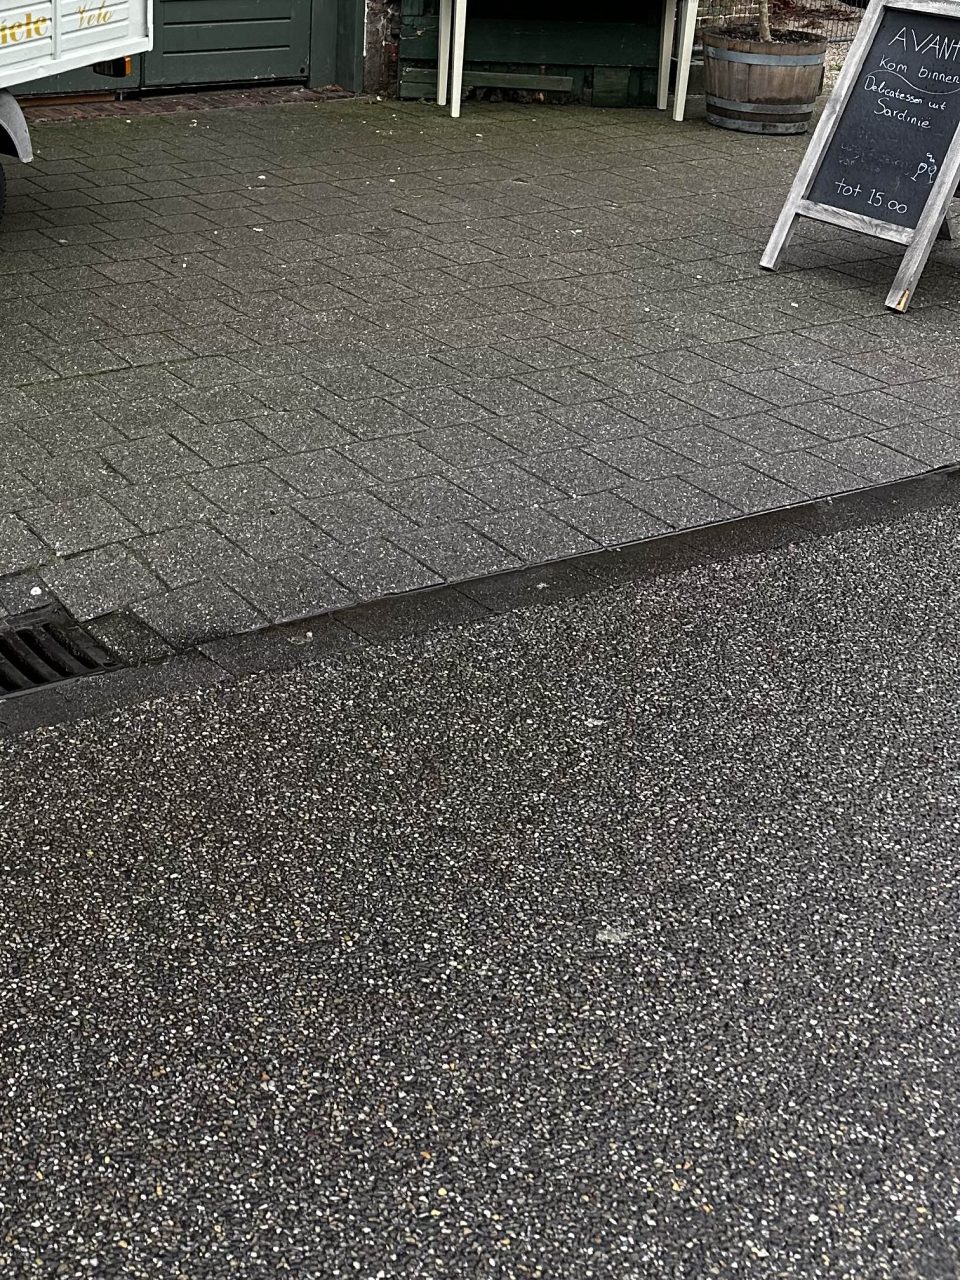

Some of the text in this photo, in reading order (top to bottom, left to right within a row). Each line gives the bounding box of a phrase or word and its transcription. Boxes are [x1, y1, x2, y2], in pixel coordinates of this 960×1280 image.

[918, 66, 960, 84] binnen
[834, 178, 908, 214] tot 15.00
